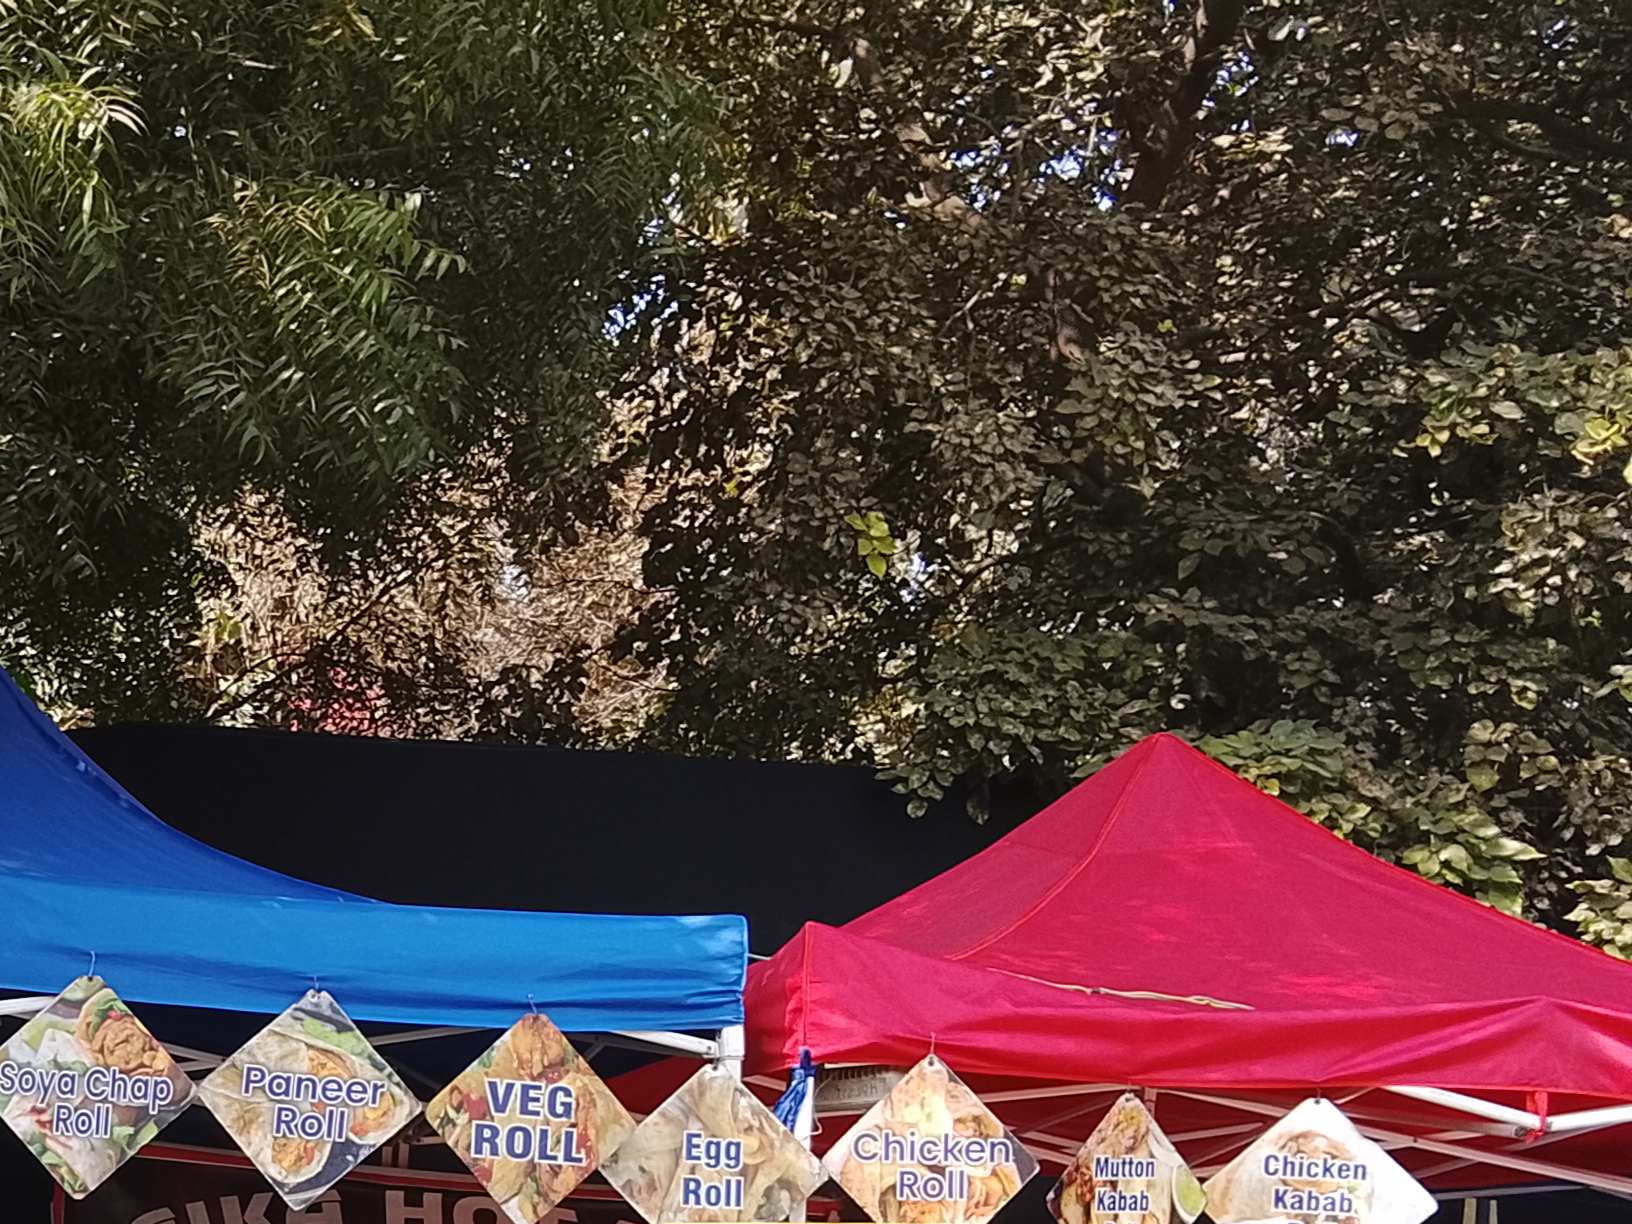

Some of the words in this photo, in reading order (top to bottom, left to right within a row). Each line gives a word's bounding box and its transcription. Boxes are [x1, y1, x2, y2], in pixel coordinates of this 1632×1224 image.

[85, 1067, 174, 1112] Chap
[243, 1064, 387, 1106] Paneer
[486, 1078, 574, 1116] VEG
[53, 1105, 112, 1138] Roll
[273, 1105, 348, 1142] Roll
[472, 1125, 586, 1165] ROLL
[684, 1131, 742, 1173] Egg
[850, 1129, 1013, 1166] Chicken
[1094, 1156, 1155, 1179] Mutton
[1263, 1154, 1367, 1181] Chicken
[682, 1176, 743, 1209] Roll
[897, 1169, 967, 1202] Roll
[1096, 1189, 1149, 1213] Kabab
[1273, 1188, 1353, 1213] Kabab
